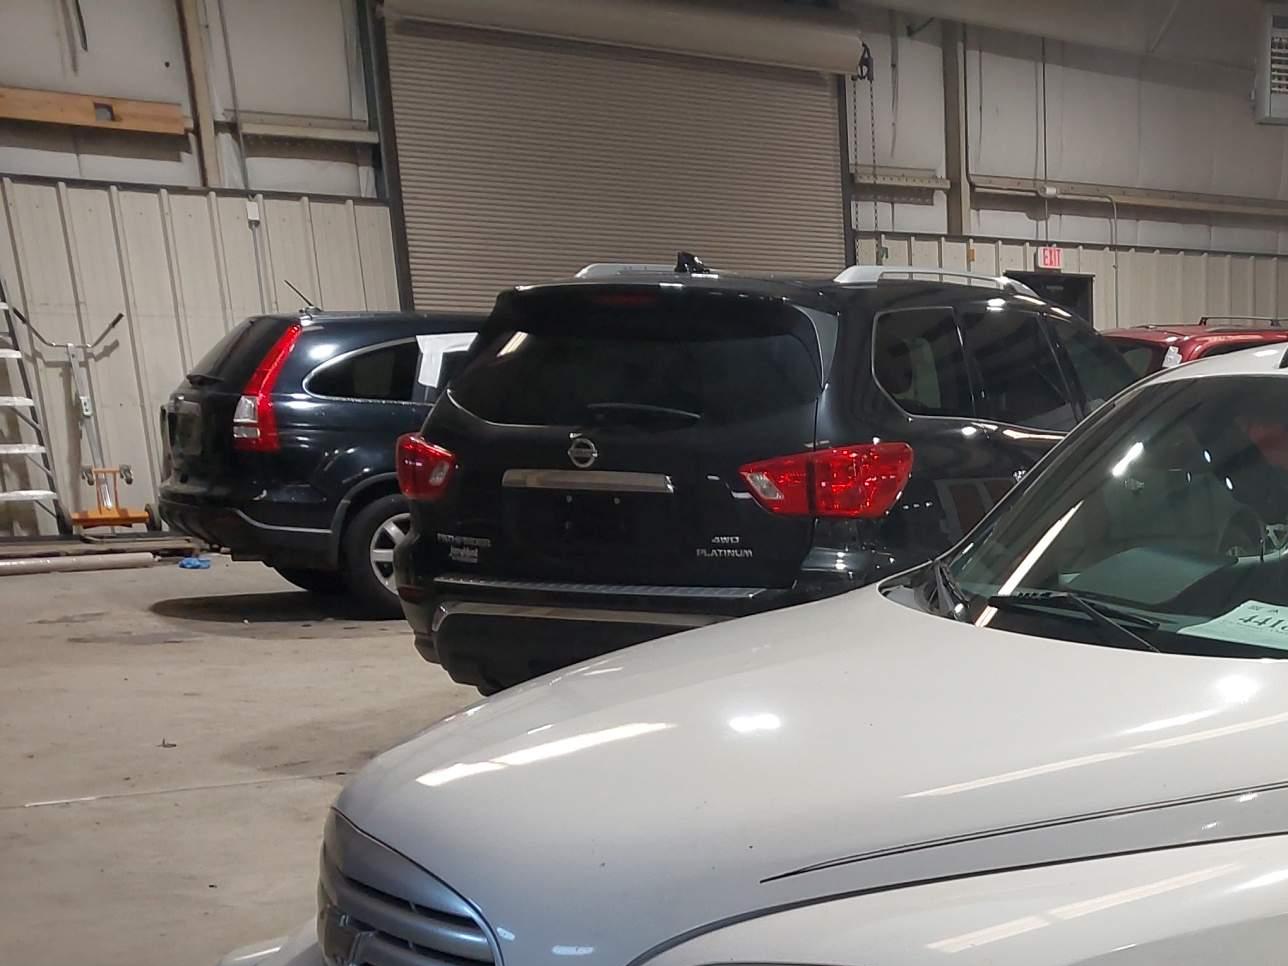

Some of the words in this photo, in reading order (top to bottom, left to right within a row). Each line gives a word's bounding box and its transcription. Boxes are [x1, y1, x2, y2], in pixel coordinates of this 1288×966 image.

[1043, 247, 1061, 266] EXIT
[711, 536, 740, 544] 4WD
[696, 548, 753, 557] PLATINUM
